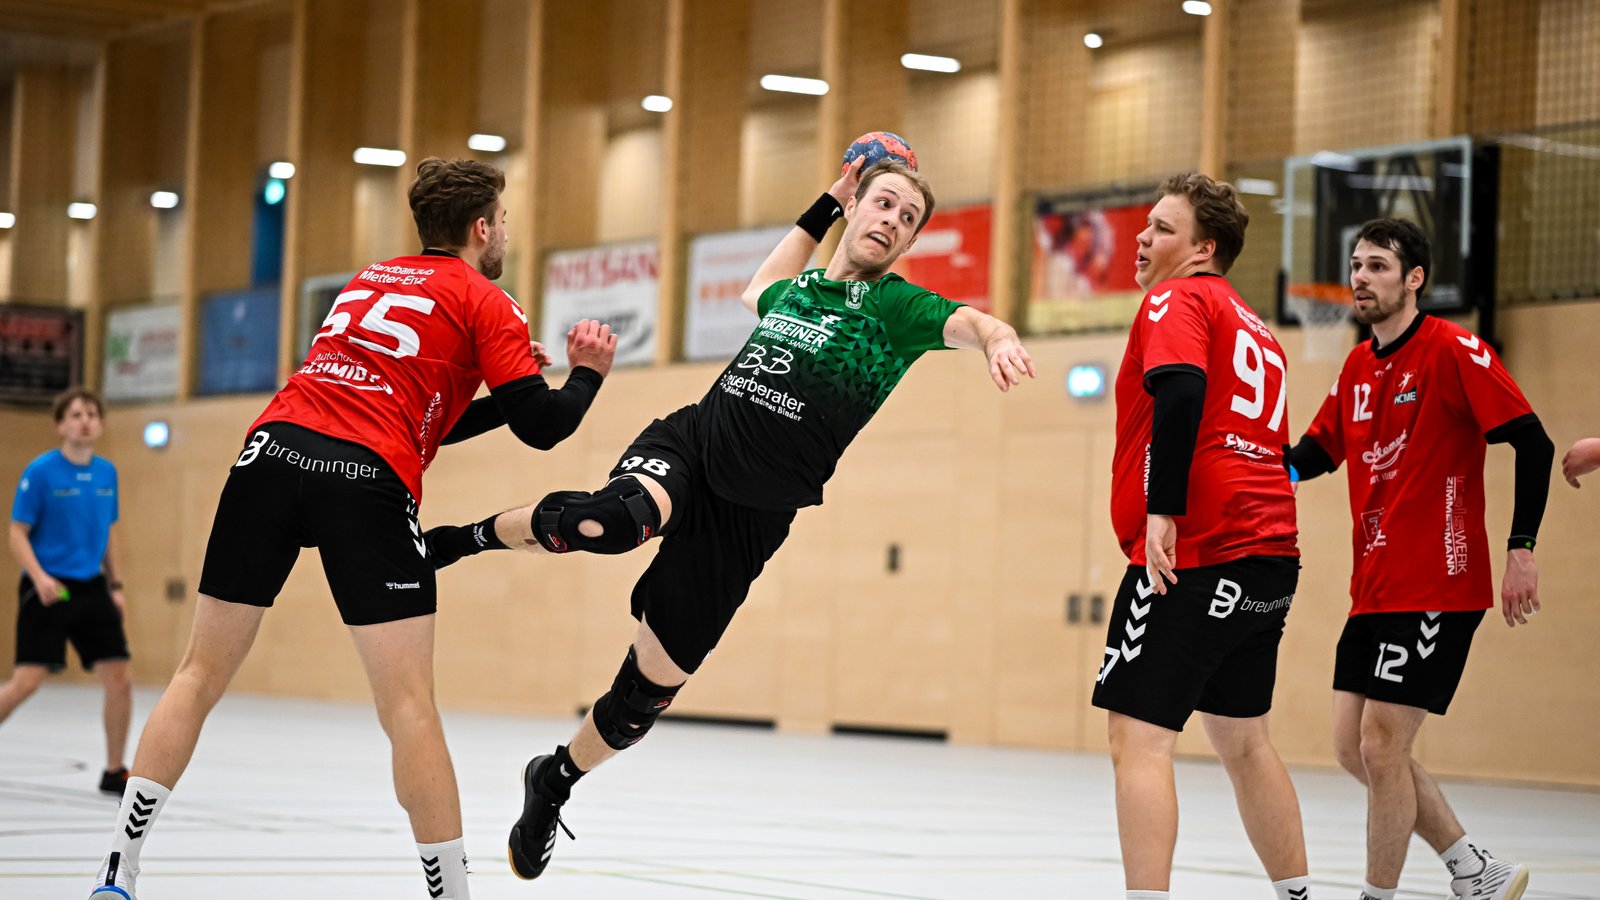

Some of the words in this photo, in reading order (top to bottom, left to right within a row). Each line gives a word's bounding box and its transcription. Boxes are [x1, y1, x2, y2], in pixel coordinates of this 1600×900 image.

[358, 270, 427, 285] Metter-Enz
[311, 289, 436, 359] 55
[1230, 329, 1286, 432] 97
[1352, 382, 1373, 422] 12
[266, 440, 380, 480] breuninger
[1374, 641, 1409, 683] 12
